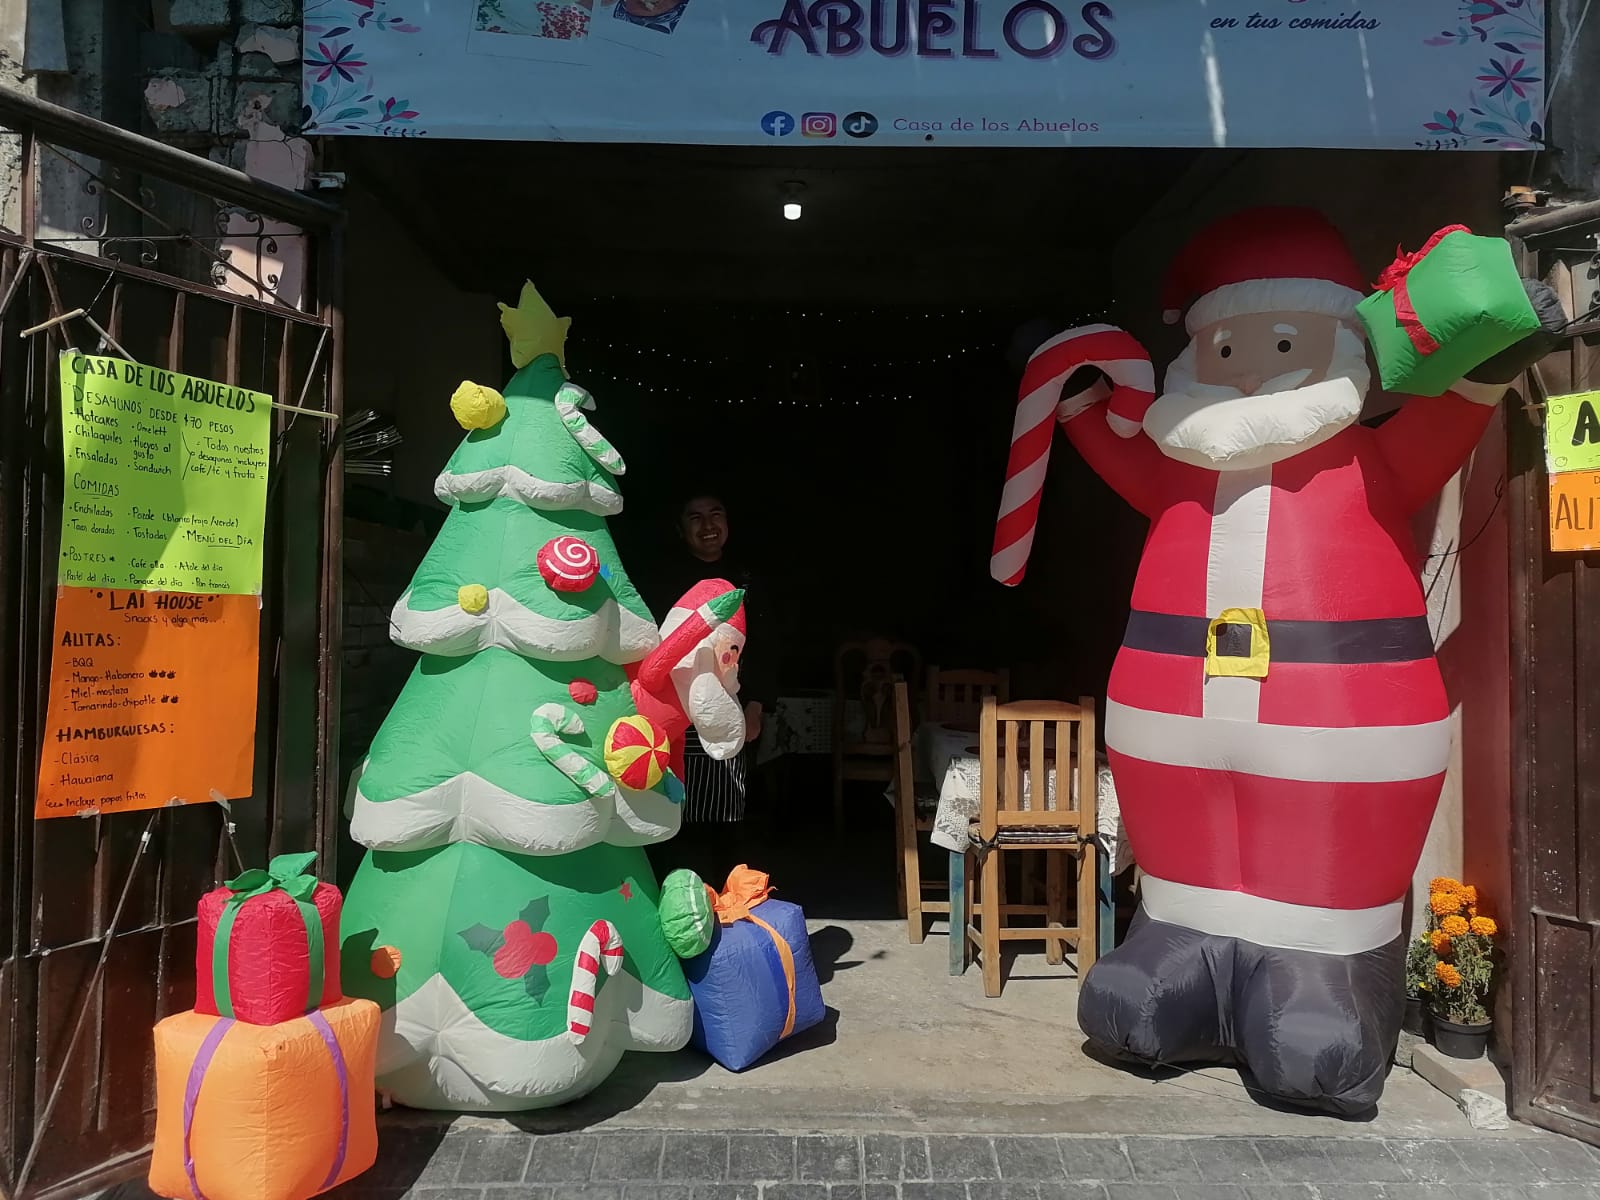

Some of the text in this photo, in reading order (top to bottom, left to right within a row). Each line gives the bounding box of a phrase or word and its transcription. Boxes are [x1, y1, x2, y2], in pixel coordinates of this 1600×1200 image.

[750, 0, 1118, 59] ABUELOS
[1210, 11, 1381, 30] en tus comidas
[893, 118, 1099, 132] Casa de los Abuelos
[72, 356, 255, 413] CASA DE LOS ABUELOS
[73, 385, 234, 434] DESAYUNOS DESDE $70 PESOS
[75, 425, 122, 444] Chilaquiles
[163, 444, 170, 452] al
[137, 423, 168, 436] Omelett
[133, 449, 154, 460] gusto
[204, 436, 264, 455] Todos nuestros
[75, 448, 172, 475] Ensaladas Sandwich
[198, 451, 233, 465] desayunos
[233, 466, 255, 479] fruta
[74, 473, 119, 497] COMIDAS
[74, 502, 113, 517] Enchiladas
[1555, 493, 1600, 530] ALI
[133, 527, 167, 540] Tostadas
[219, 537, 233, 545] DEL
[87, 571, 96, 581] del
[157, 577, 166, 585] del
[109, 591, 204, 611] LAI HOUSE
[162, 615, 168, 625] y
[172, 613, 188, 627] algo
